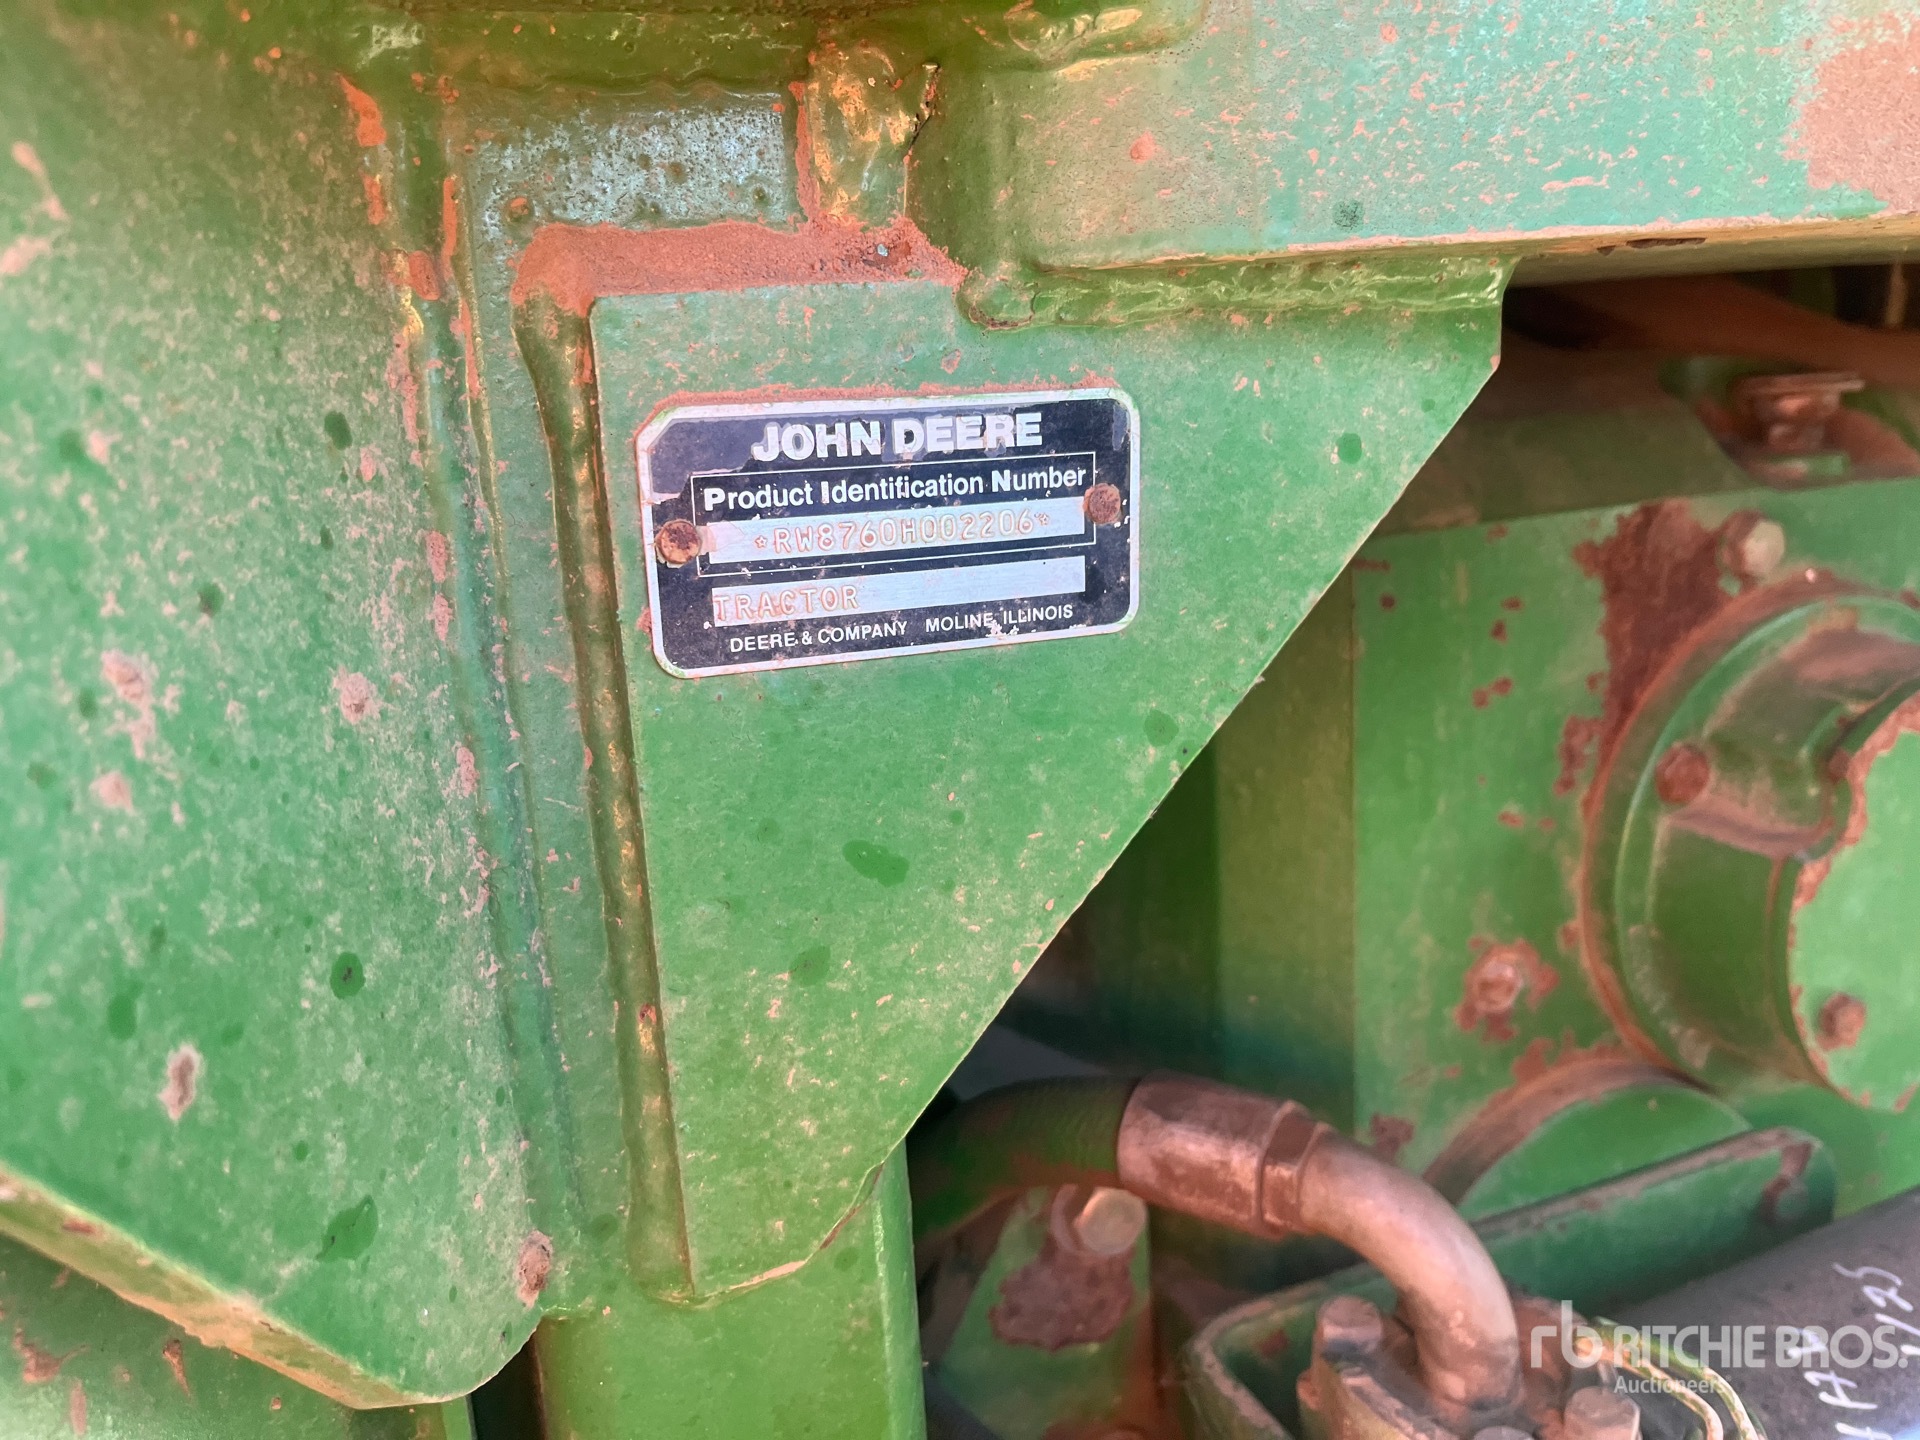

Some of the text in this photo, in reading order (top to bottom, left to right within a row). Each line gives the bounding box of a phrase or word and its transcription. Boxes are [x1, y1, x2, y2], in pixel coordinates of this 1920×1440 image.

[753, 412, 1043, 462] JOHN DEERE
[704, 465, 1087, 512] Product Identification Number
[713, 585, 859, 622] TRACTOR
[730, 632, 796, 653] DEERE
[801, 630, 814, 646] &
[818, 620, 908, 644] COMPANY
[1003, 604, 1073, 625] ILLINOIS
